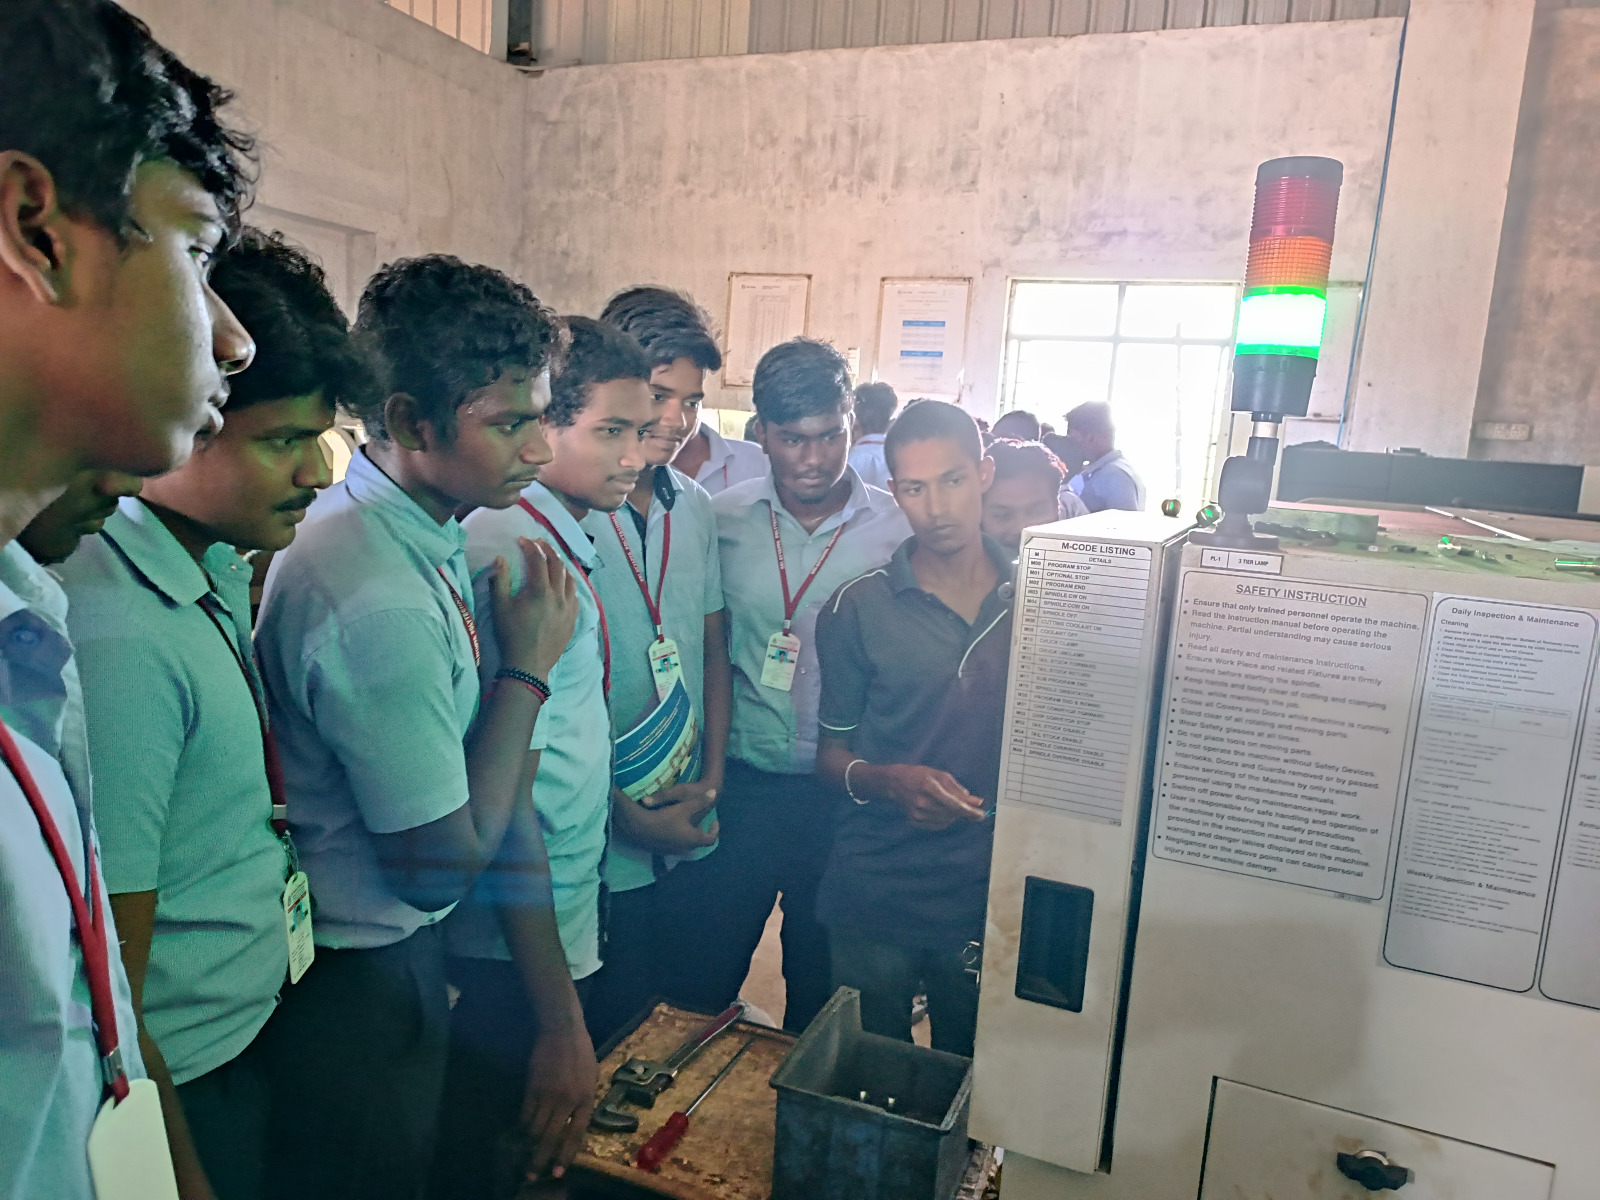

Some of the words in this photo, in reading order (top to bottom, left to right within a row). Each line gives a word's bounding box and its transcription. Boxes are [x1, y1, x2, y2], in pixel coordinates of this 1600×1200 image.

[1062, 542, 1097, 552] M-CODE
[1100, 546, 1136, 556] LISTING
[1235, 584, 1281, 597] SAFETY
[1282, 589, 1367, 607] INSTRUCTION
[1191, 609, 1212, 617] Read
[1213, 611, 1226, 619] the
[1227, 613, 1269, 624] instruction
[1271, 619, 1301, 628] manual
[1302, 622, 1329, 631] before
[1331, 626, 1371, 638] operating
[1373, 630, 1387, 638] the
[1192, 598, 1220, 607] Ensure
[1221, 601, 1237, 609] that
[1238, 604, 1255, 613] only
[1256, 605, 1285, 615] trained
[1286, 610, 1329, 619] personnel
[1330, 615, 1362, 623] operate
[1363, 617, 1378, 625] the
[1379, 620, 1419, 630] machine.
[1440, 619, 1469, 628] Cleaning
[1452, 607, 1472, 617] Daily
[1473, 610, 1516, 622] Inspection
[1526, 615, 1579, 628] Maintenance
[1188, 631, 1212, 642] injury.
[1189, 621, 1225, 630] machine.
[1226, 624, 1252, 633] Partial
[1253, 628, 1311, 643] understanding
[1313, 636, 1331, 645] may
[1332, 638, 1358, 646] cause
[1359, 641, 1392, 650] serious
[1187, 642, 1207, 651] Read
[1220, 647, 1244, 657] safety
[1262, 653, 1313, 664] maintenance
[1315, 658, 1367, 671] instructions.
